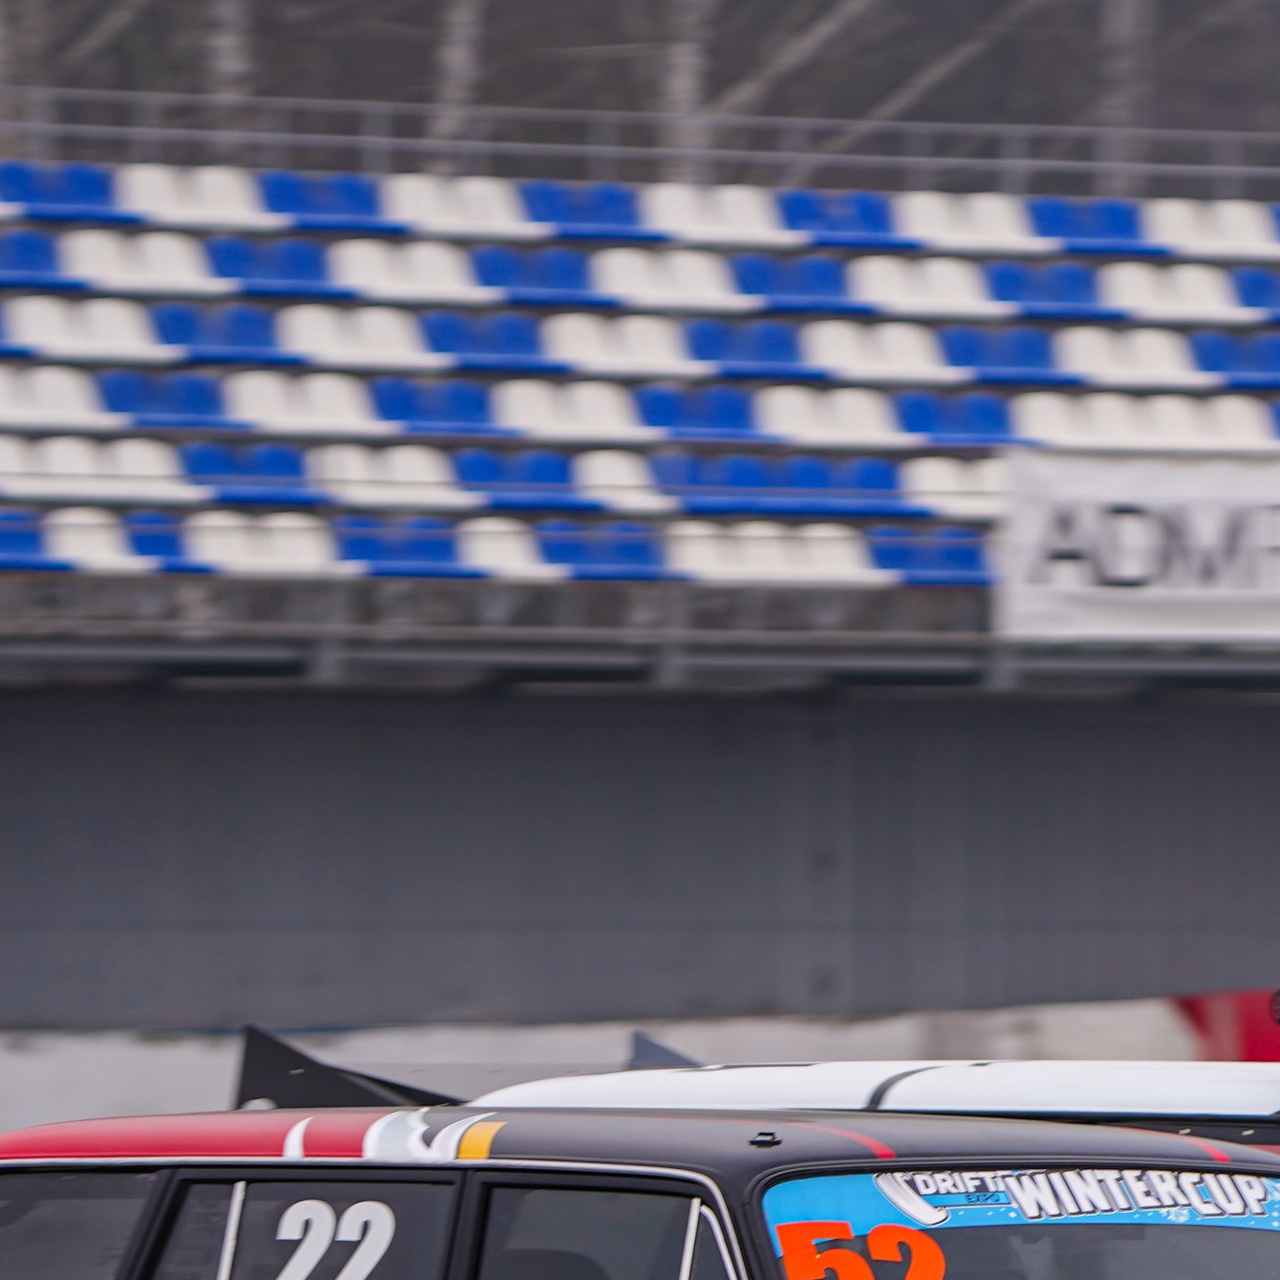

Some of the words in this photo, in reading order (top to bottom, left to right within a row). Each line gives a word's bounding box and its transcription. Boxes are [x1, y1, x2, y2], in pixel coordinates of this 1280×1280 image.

[917, 1173, 1000, 1196] DRIFT
[1008, 1170, 1192, 1220] WINTER
[1182, 1173, 1270, 1218] CUP
